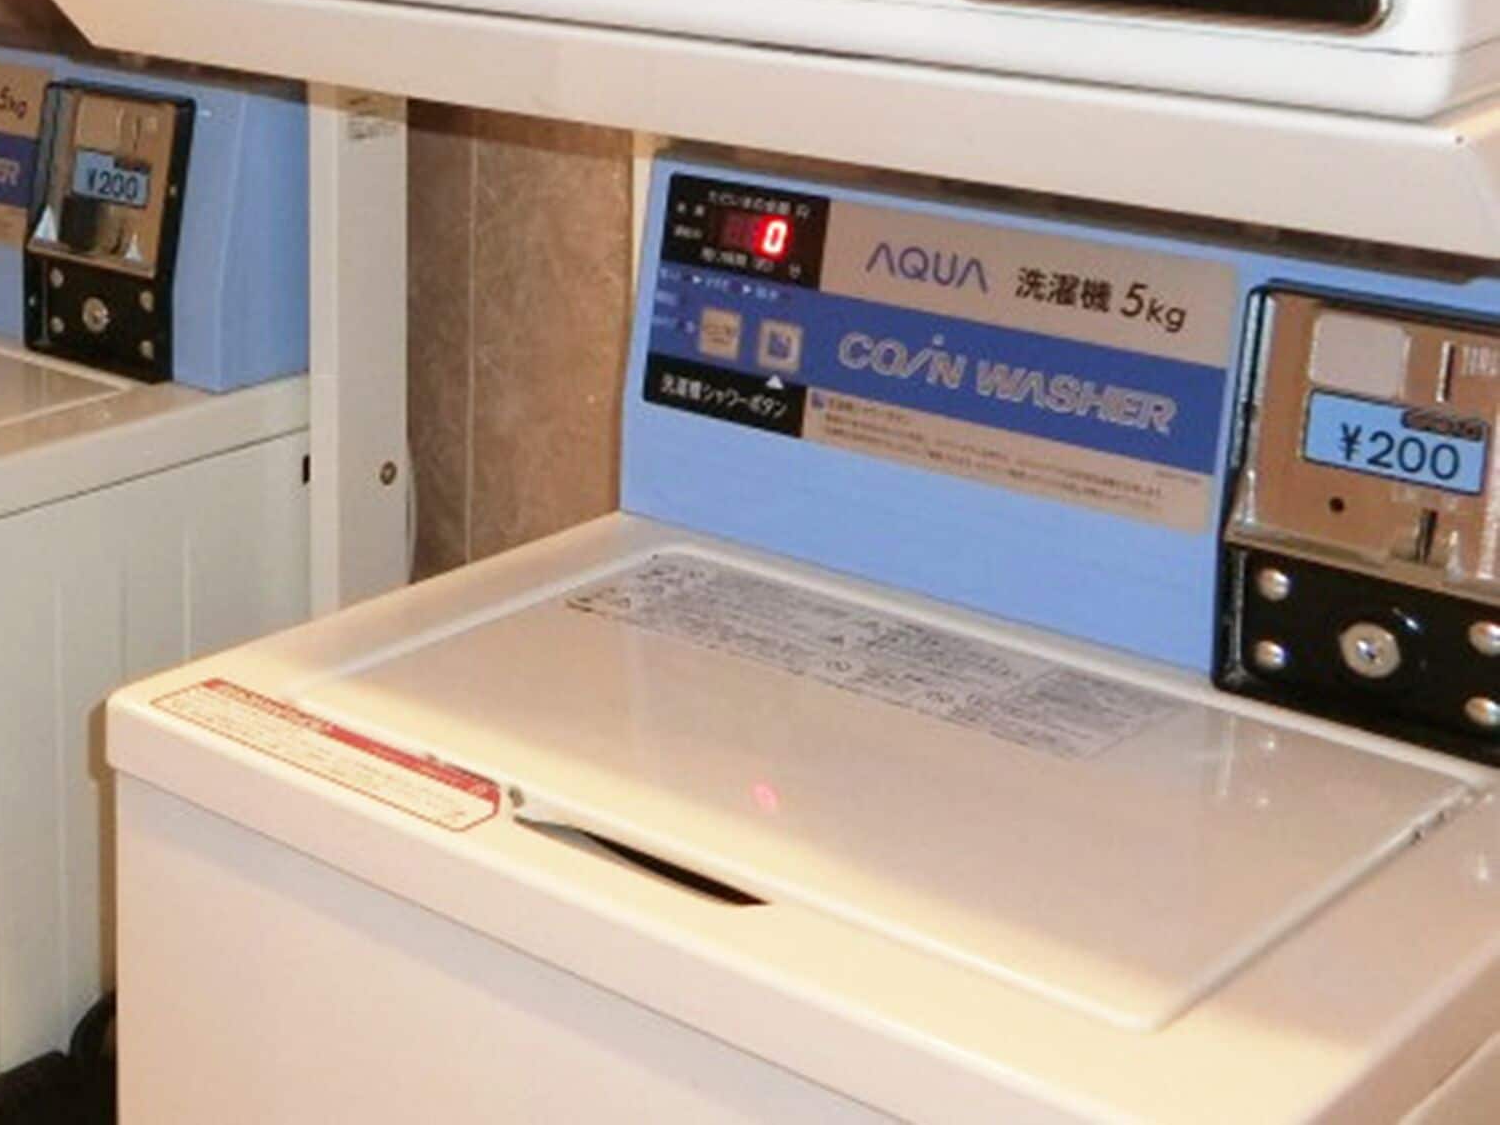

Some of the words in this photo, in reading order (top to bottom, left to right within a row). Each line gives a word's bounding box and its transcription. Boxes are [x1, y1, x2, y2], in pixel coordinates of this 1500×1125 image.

[762, 220, 788, 255] 0
[866, 241, 989, 293] AQUA
[1015, 266, 1111, 312] 洗濯機
[1119, 283, 1188, 334] 5kg
[974, 357, 1179, 435] WASHER
[1338, 421, 1461, 481] ¥200
